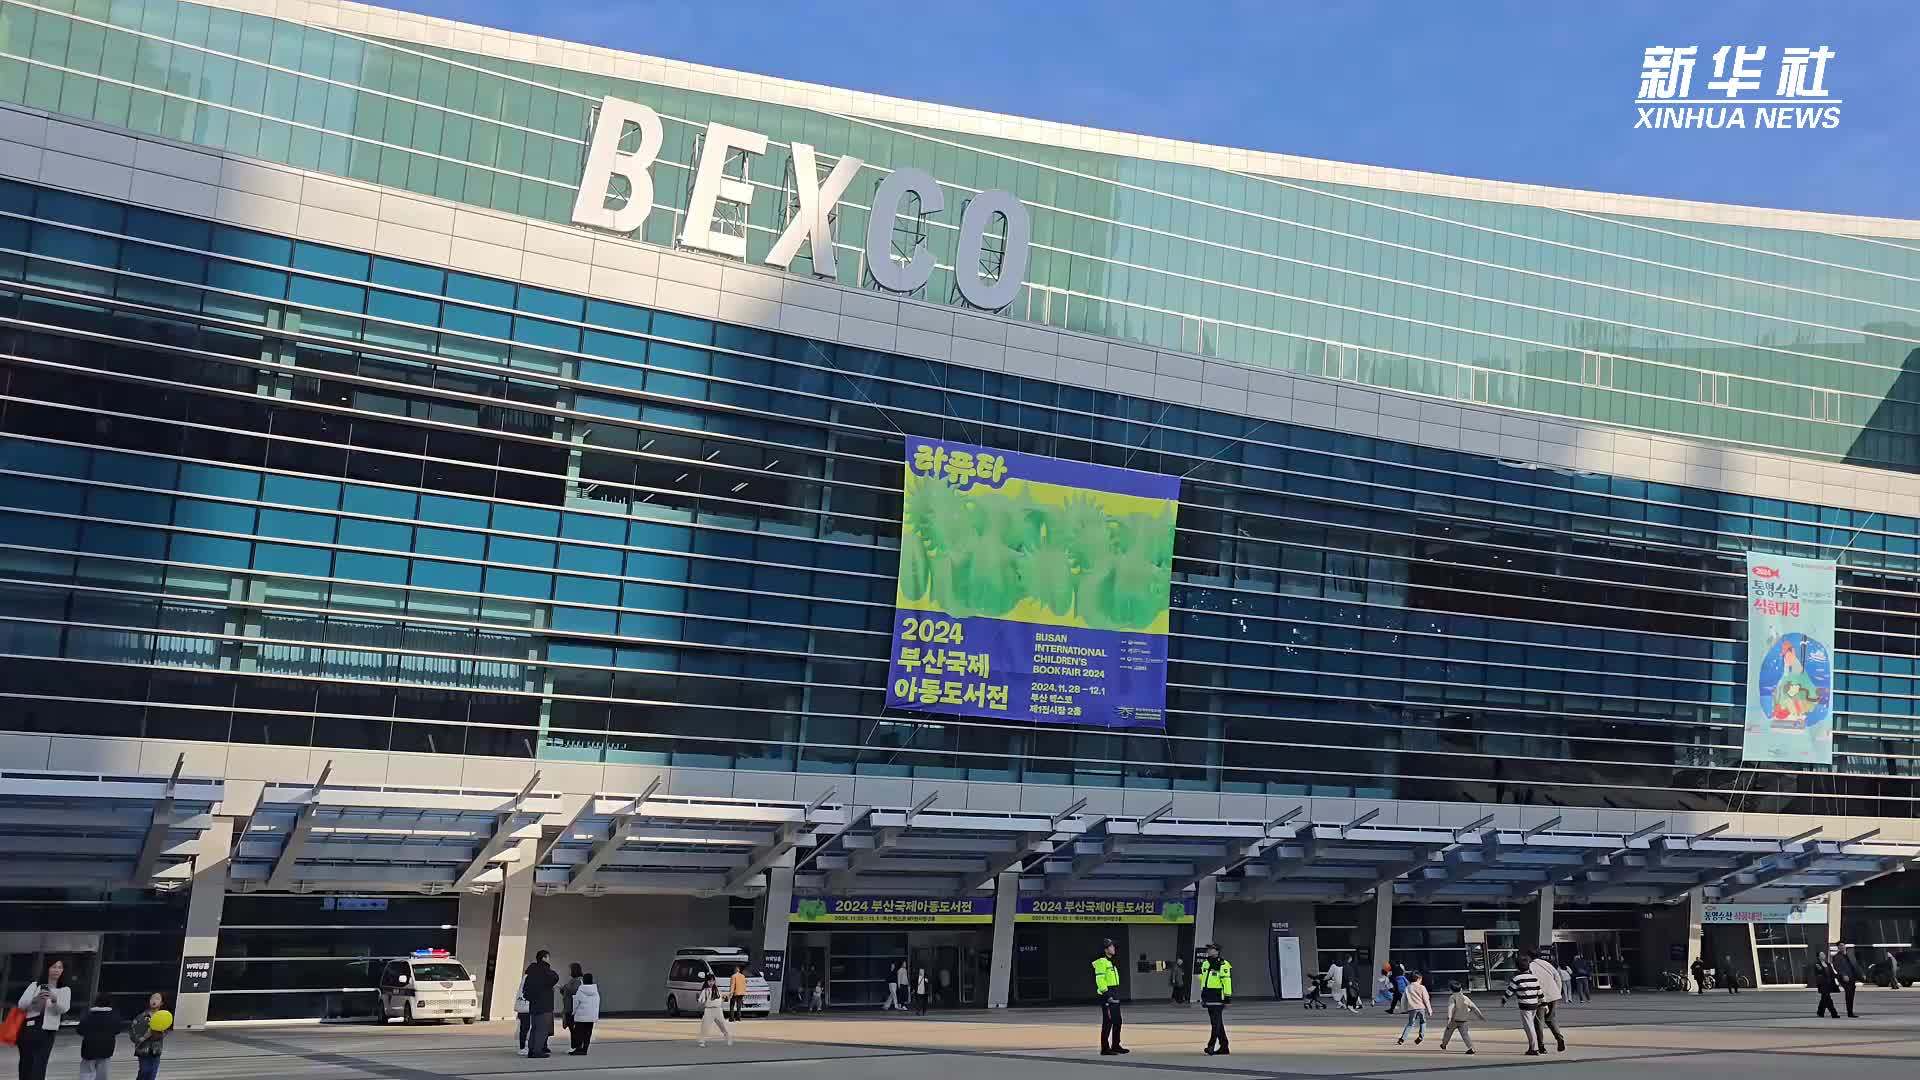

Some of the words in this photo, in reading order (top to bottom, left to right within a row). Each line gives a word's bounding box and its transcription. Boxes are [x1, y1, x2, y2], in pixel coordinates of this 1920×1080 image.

[571, 95, 1030, 311] BEXCO
[901, 617, 964, 644] 2024
[1035, 633, 1067, 643] BUSAN
[1035, 644, 1107, 657] INTERNATIONAL
[897, 647, 990, 678] 부산국제
[1034, 655, 1088, 666] CHILDREN'S
[1033, 666, 1061, 675] BOOK
[1062, 667, 1081, 676] FAIR
[1082, 669, 1105, 678] 2024
[894, 677, 1009, 710] 아동도서전
[835, 900, 869, 912] 2024
[1032, 901, 1062, 912] 2024
